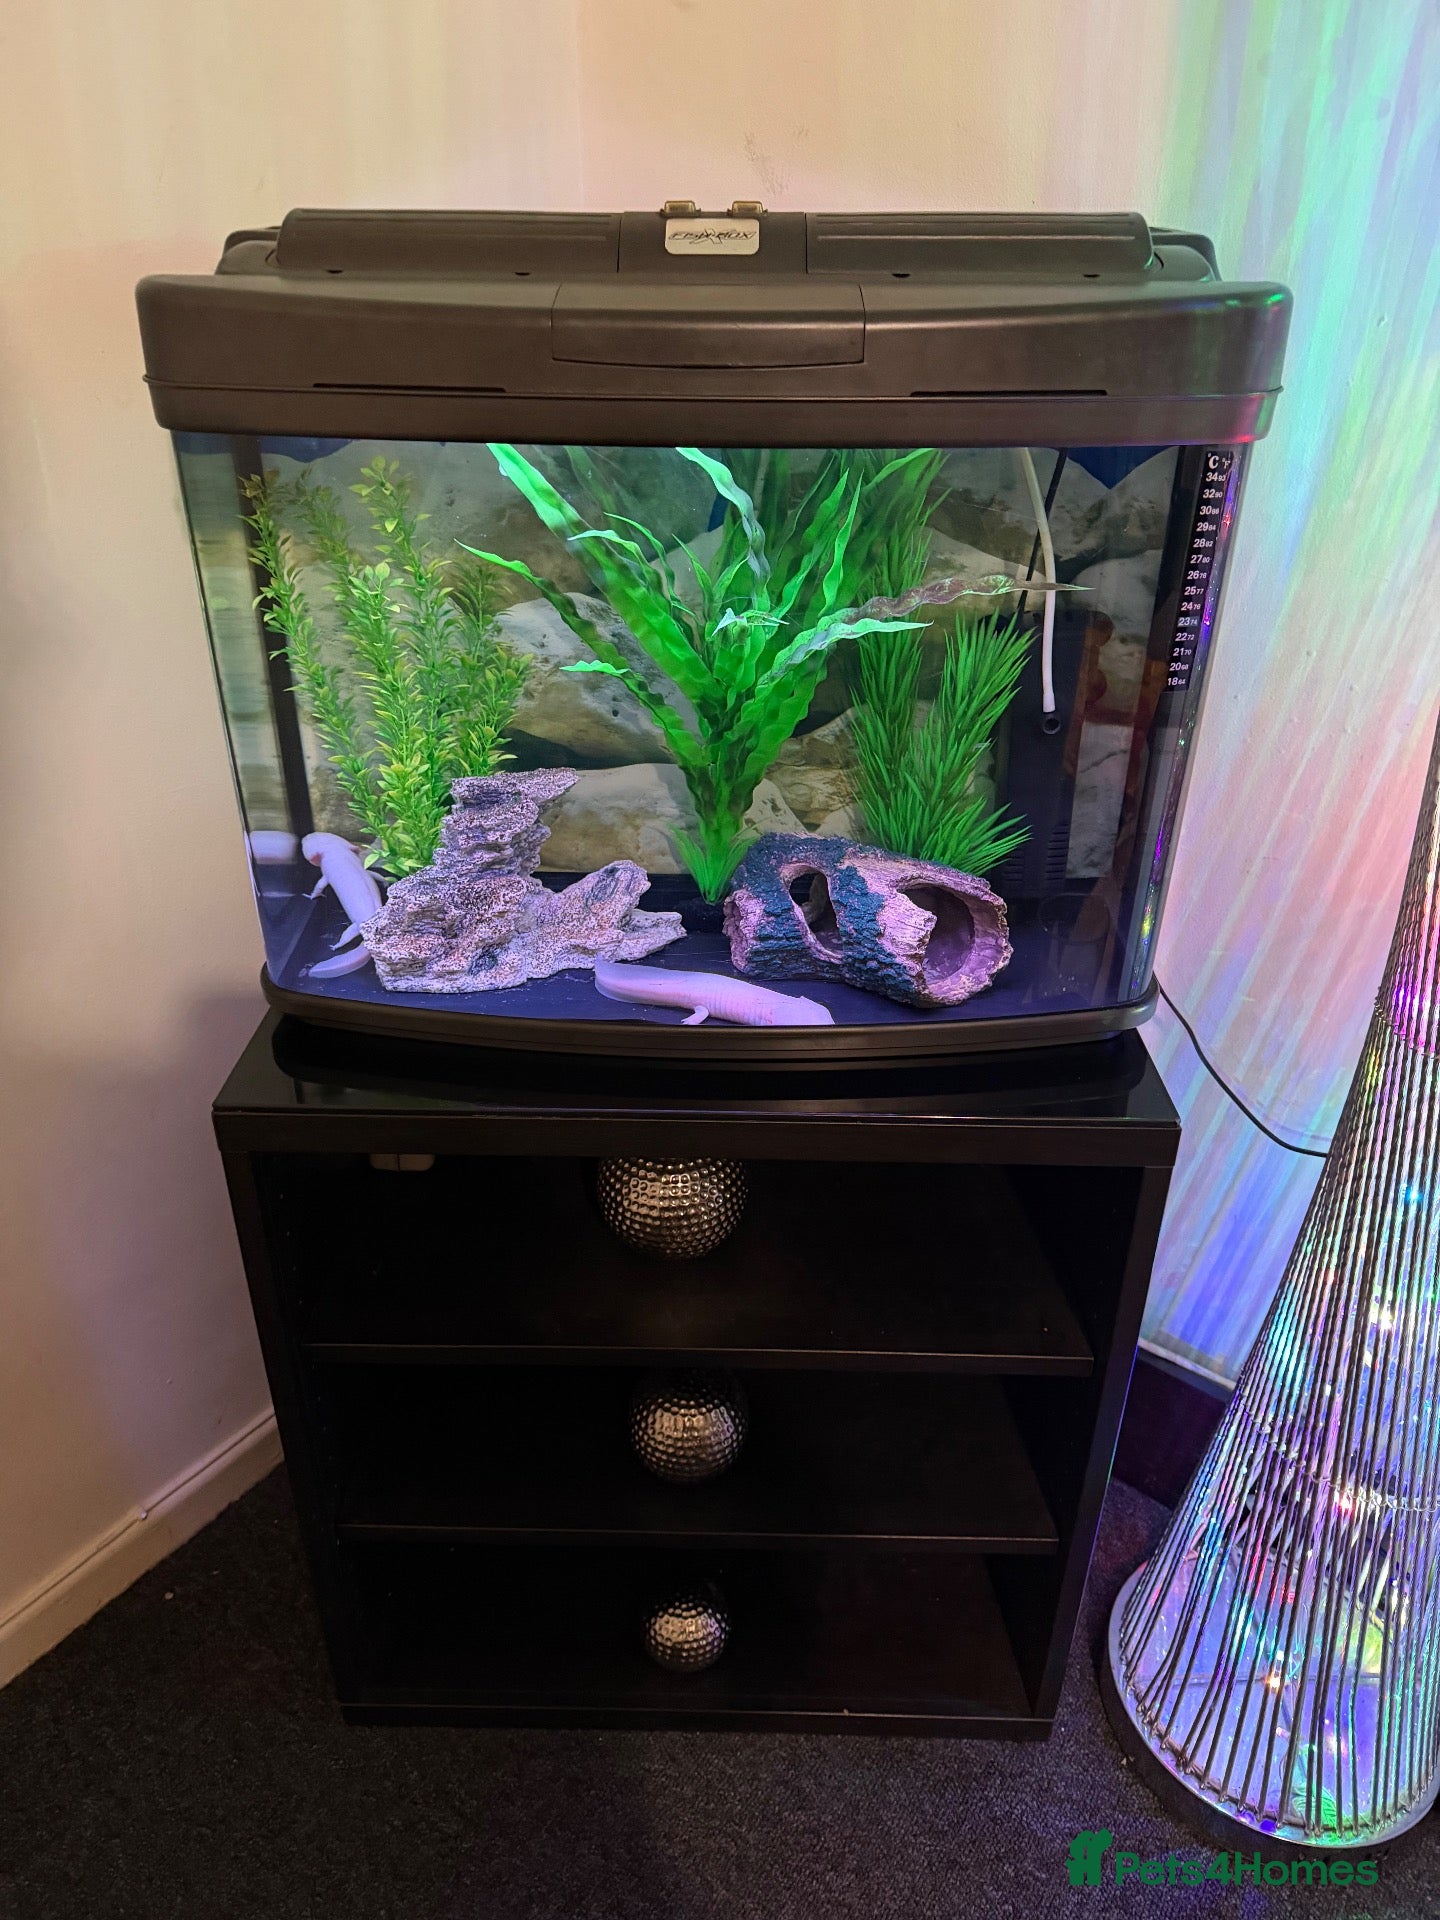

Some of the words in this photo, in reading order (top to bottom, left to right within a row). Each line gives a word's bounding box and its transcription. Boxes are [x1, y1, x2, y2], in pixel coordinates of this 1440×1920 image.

[1205, 472, 1218, 482] 34
[1203, 489, 1215, 498] 32
[1200, 505, 1212, 515] 30
[1196, 522, 1208, 532] 29
[1193, 538, 1206, 548] 28
[1190, 554, 1203, 564] 27
[1187, 570, 1199, 580] 26
[1184, 586, 1196, 596] 25
[1181, 601, 1193, 611] 24
[1178, 616, 1190, 626] 23
[1175, 632, 1187, 641] 22
[1173, 647, 1184, 656] 21
[1169, 662, 1181, 671] 20
[1167, 677, 1178, 686] 18
